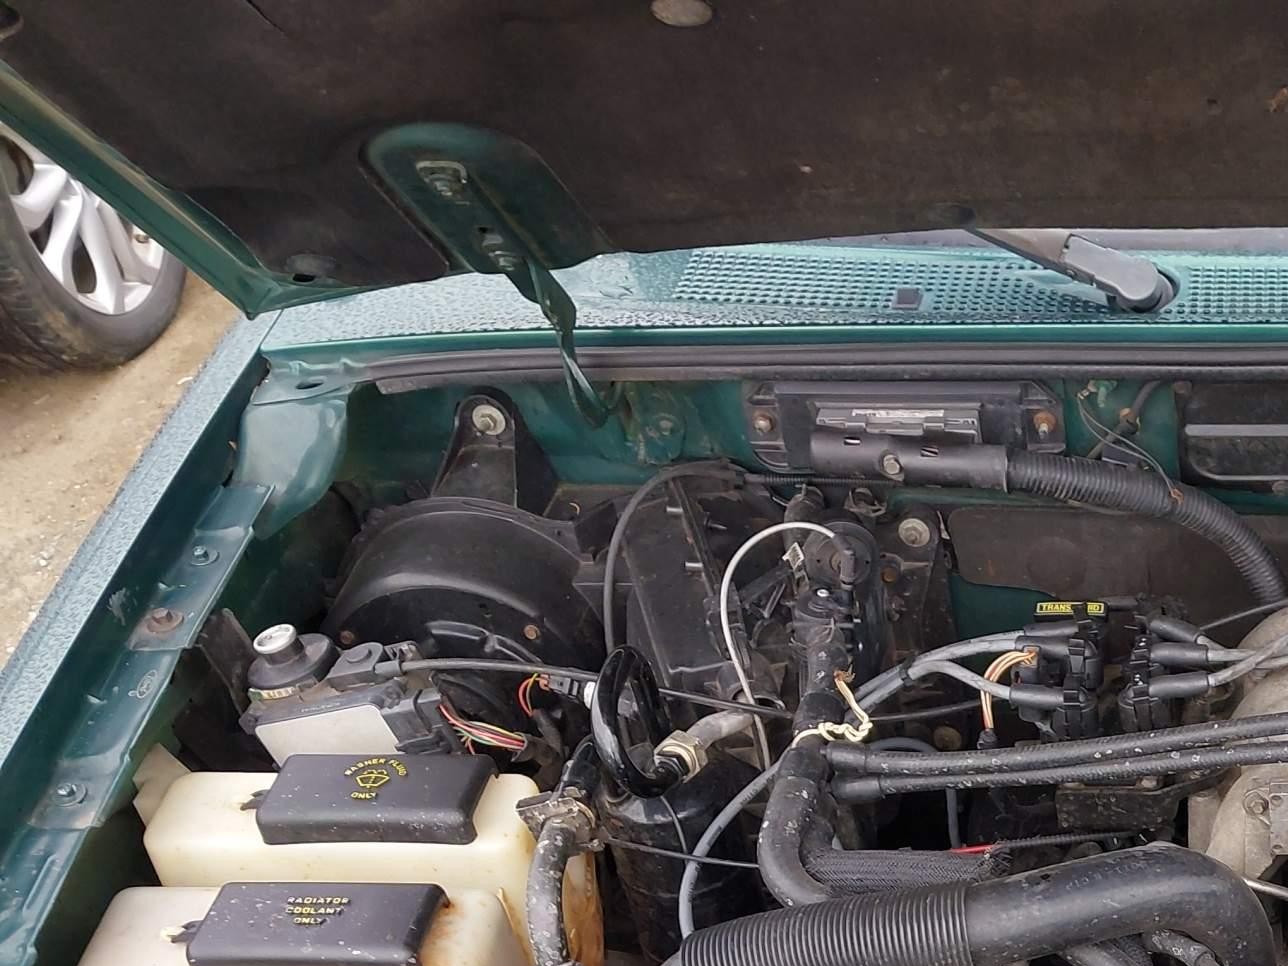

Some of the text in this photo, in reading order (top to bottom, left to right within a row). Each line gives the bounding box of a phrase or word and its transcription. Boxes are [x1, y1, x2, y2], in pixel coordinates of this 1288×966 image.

[1042, 603, 1072, 612] TRANS
[344, 758, 407, 776] WASHER FLUID
[351, 791, 377, 799] ONLY
[285, 906, 344, 914] COOLANT
